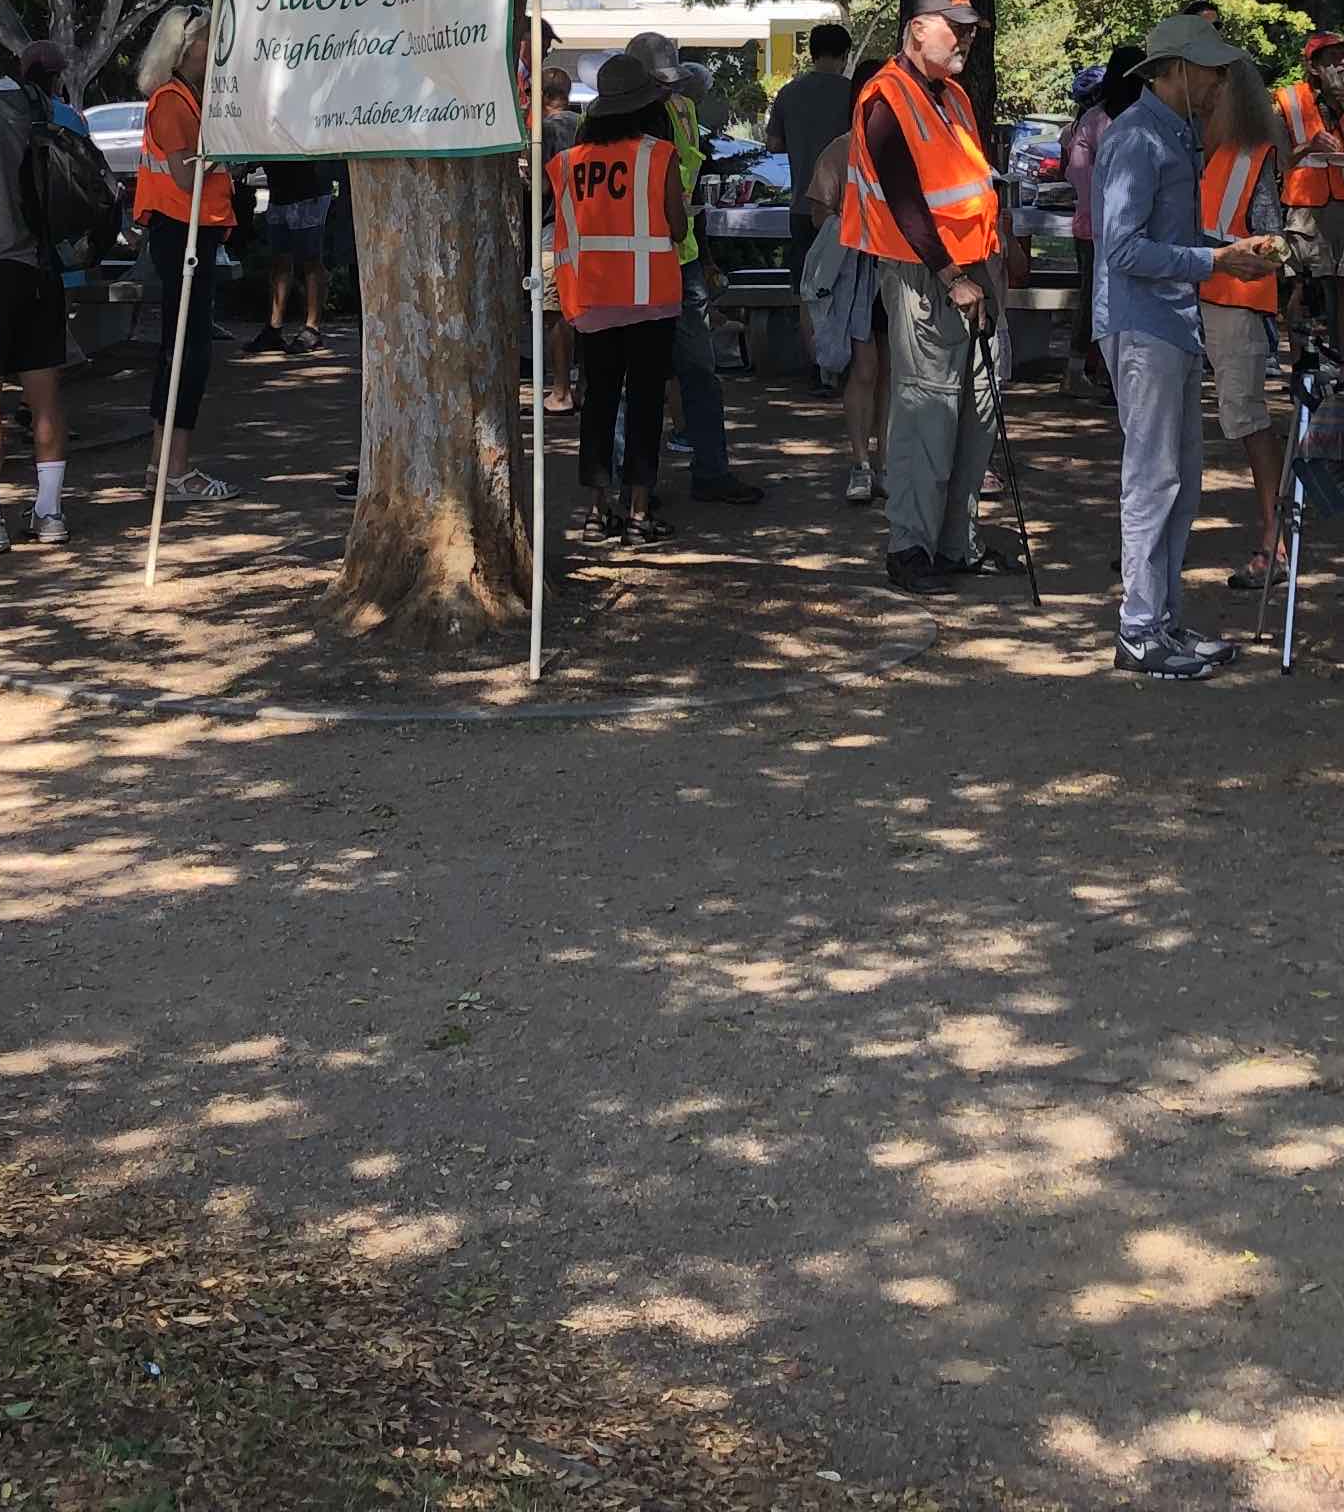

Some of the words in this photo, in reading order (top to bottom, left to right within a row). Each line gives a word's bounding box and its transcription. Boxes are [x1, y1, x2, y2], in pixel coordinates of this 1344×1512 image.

[253, 29, 404, 70] Neighborhood
[401, 20, 488, 56] Association
[573, 160, 628, 202] BPC
